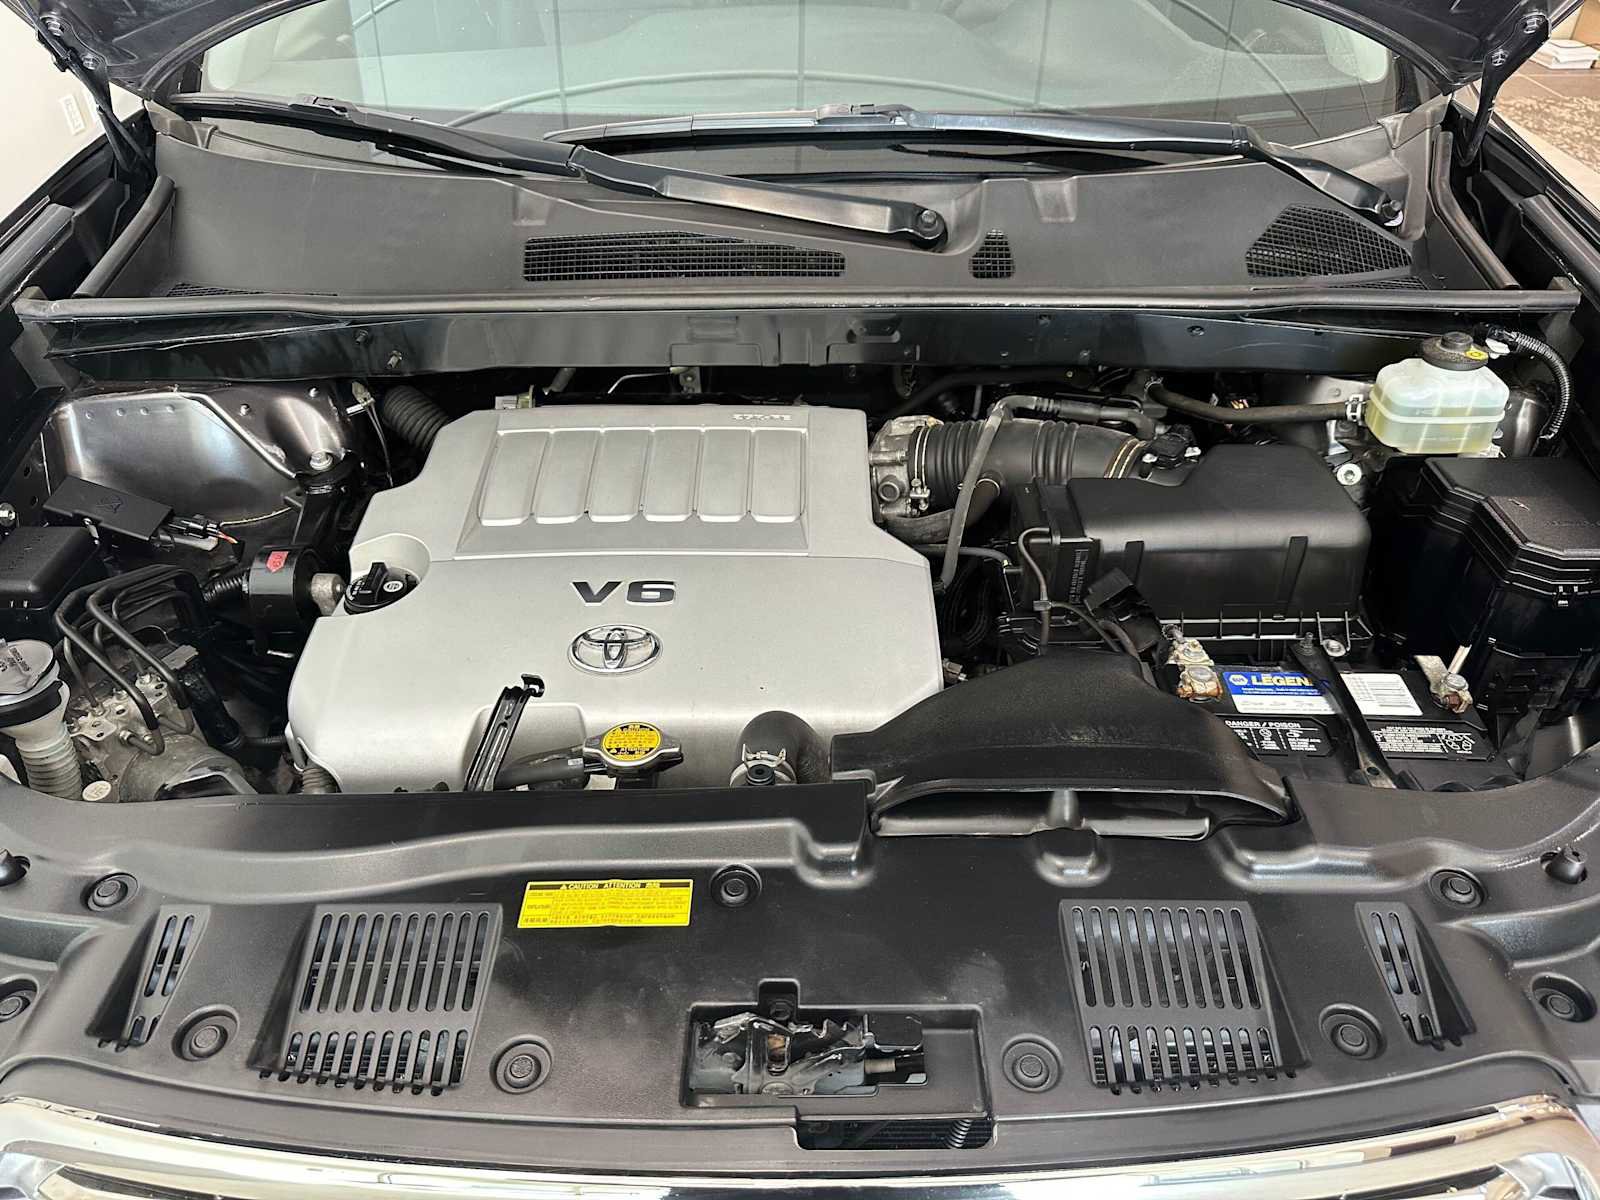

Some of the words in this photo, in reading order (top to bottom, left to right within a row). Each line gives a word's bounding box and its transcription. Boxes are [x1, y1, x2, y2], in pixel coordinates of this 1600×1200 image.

[570, 580, 677, 606] V6
[1251, 675, 1314, 686] LEGEN
[1225, 720, 1261, 728] DANGER
